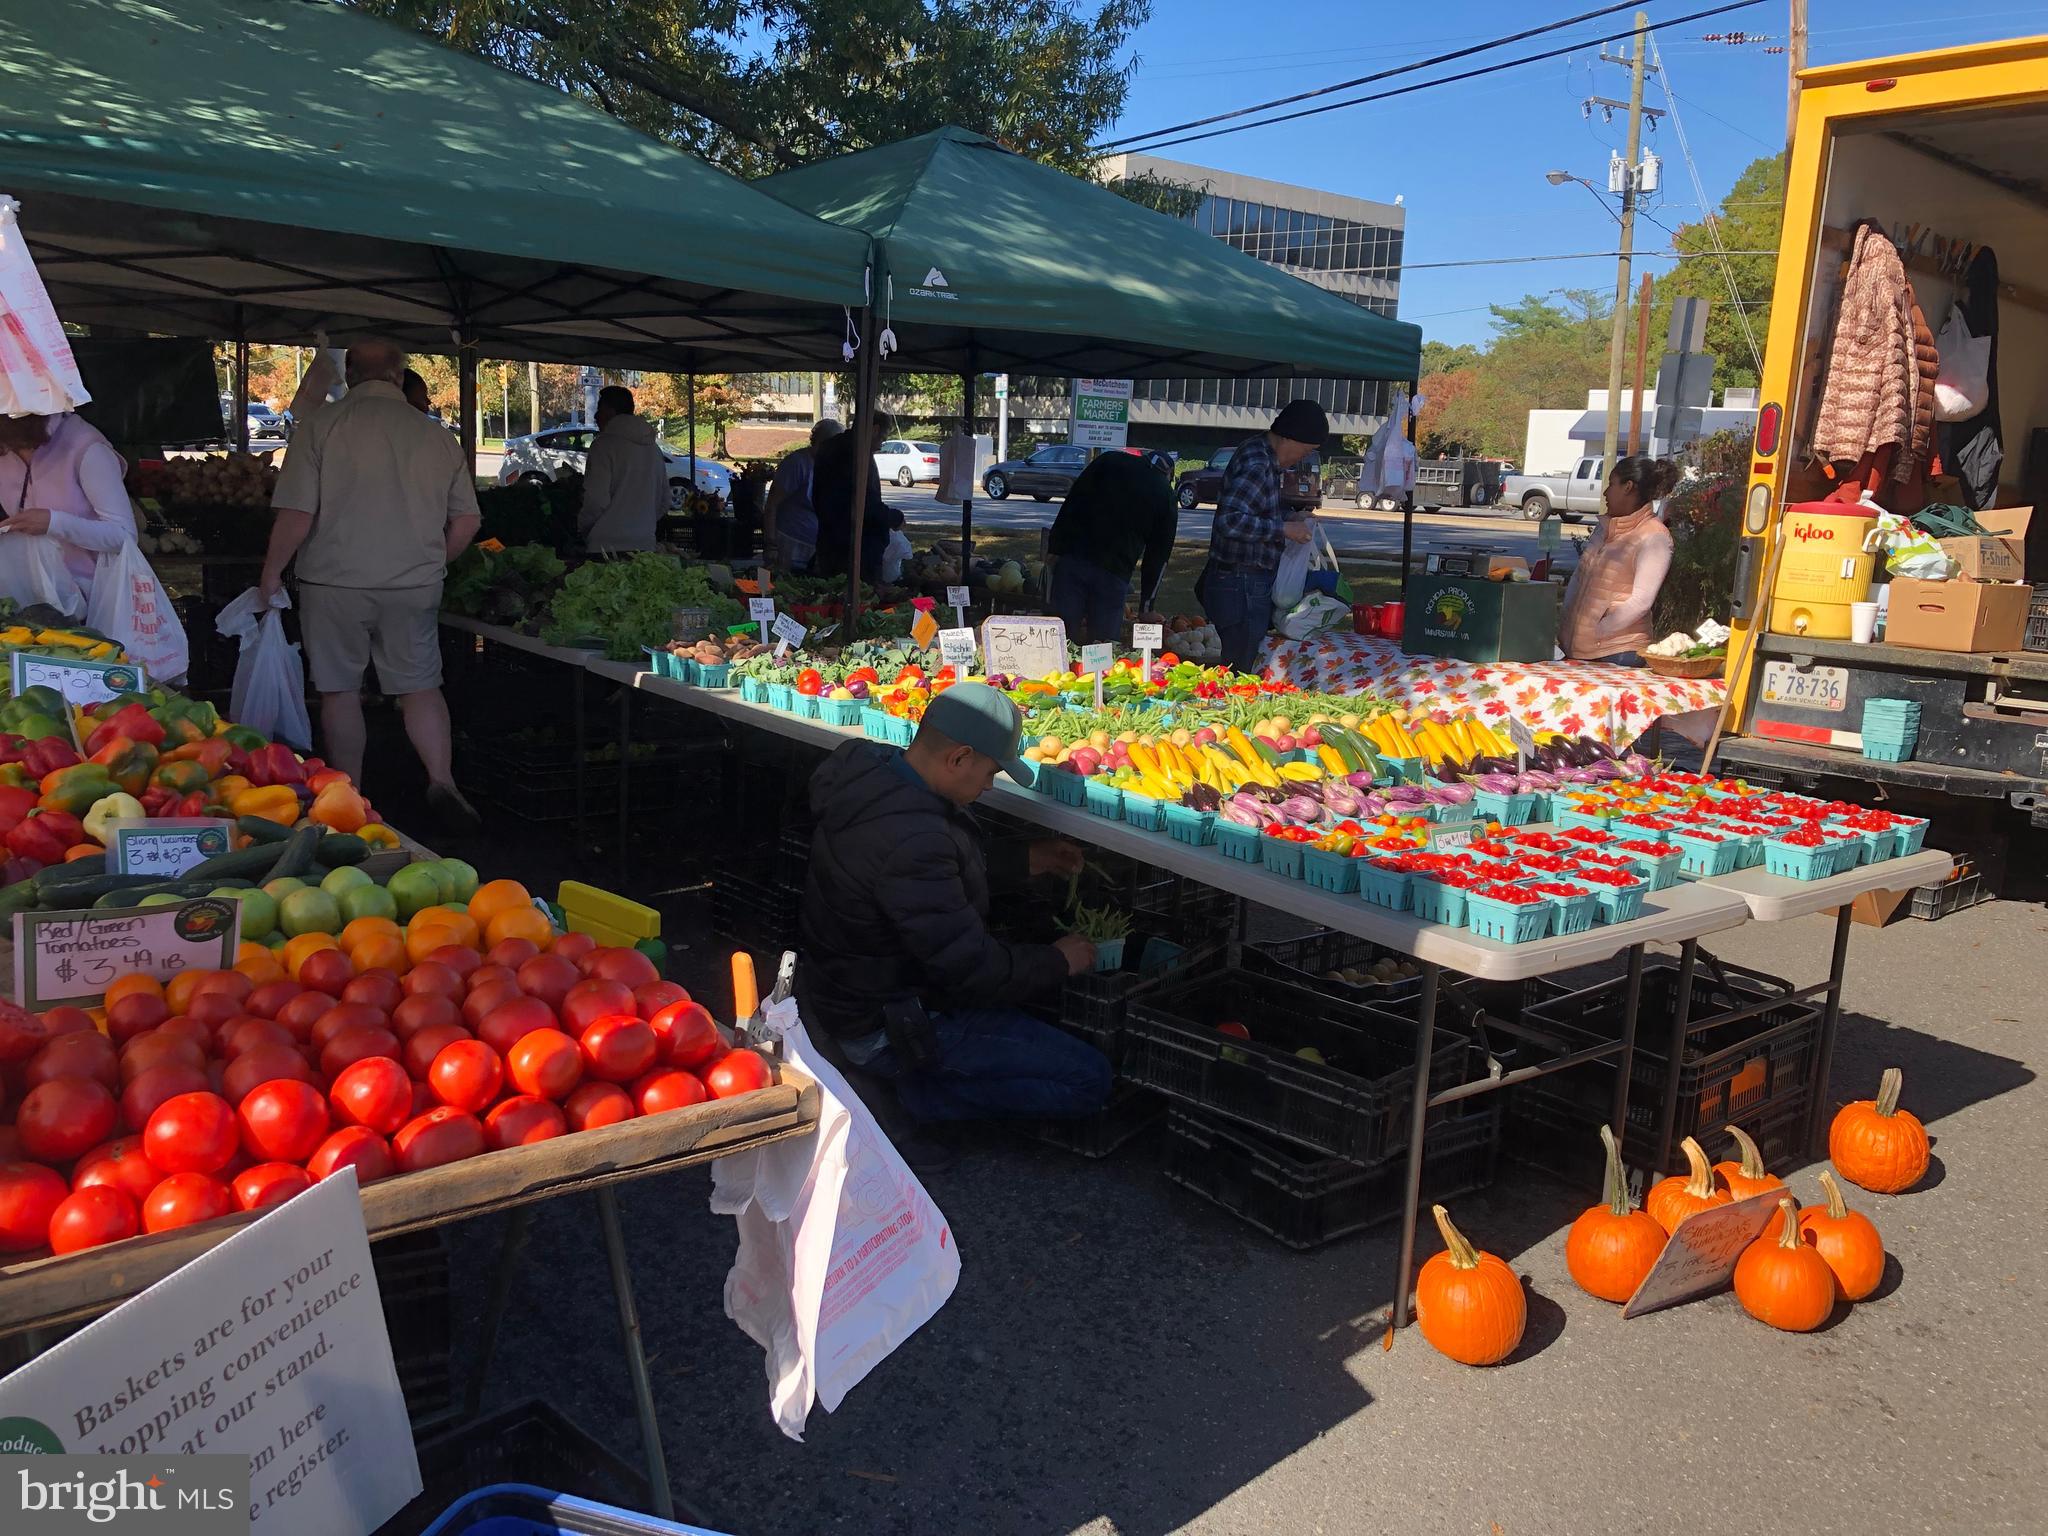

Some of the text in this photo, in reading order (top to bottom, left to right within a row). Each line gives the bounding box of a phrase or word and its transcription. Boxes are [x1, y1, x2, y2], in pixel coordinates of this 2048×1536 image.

[1081, 398, 1124, 411] FARMERS
[1083, 409, 1121, 421] MARKET
[1793, 522, 1834, 543] igloo
[1981, 550, 2011, 567] T-Shirt
[991, 627, 1012, 653] 3
[28, 664, 46, 682] 3
[1767, 672, 1840, 699] F 78-736
[128, 849, 144, 866] 3
[36, 935, 141, 954] Tomatoes
[222, 1272, 361, 1382] convenience
[73, 1249, 334, 1440] Baskets are for your
[181, 1332, 334, 1455] at our stand.
[279, 1403, 327, 1451] here
[265, 1428, 350, 1509] register.
